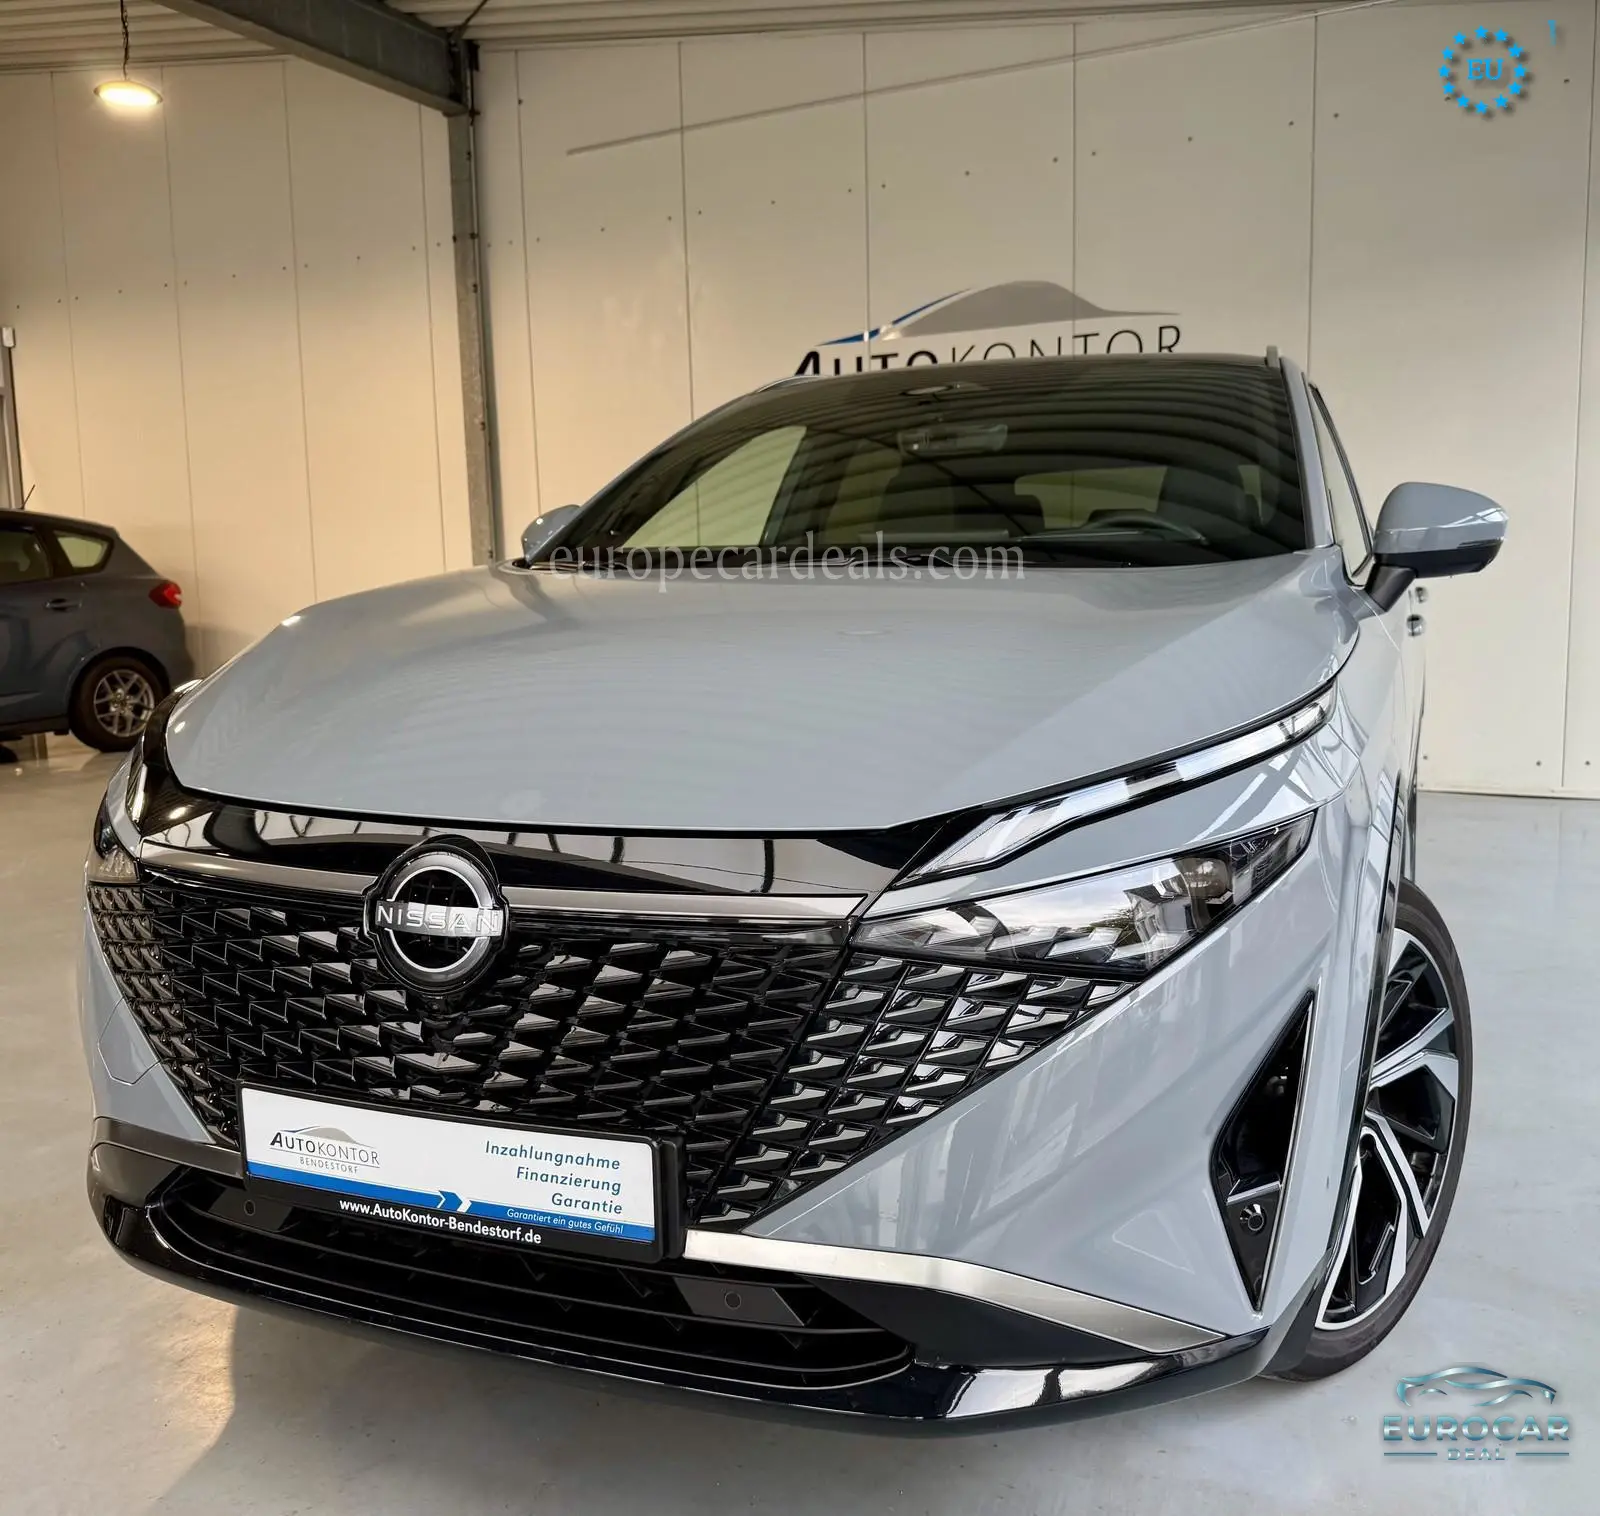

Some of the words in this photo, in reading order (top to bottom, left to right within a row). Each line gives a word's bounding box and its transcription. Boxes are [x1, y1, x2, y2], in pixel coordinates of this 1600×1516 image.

[377, 905, 499, 932] NISSAN
[269, 1132, 380, 1166] AUTOKONTOR
[485, 1140, 621, 1171] Inzahlungnahme
[299, 1156, 359, 1174] BENDESTORF
[516, 1166, 622, 1196] Finanzierung
[551, 1192, 623, 1215] Garantie
[339, 1199, 542, 1244] www.AutoKontor-Bendestorf.de
[506, 1208, 551, 1224] Garantiert
[552, 1216, 566, 1226] ein
[568, 1219, 592, 1232] gutes
[594, 1221, 624, 1235] Gefühl
